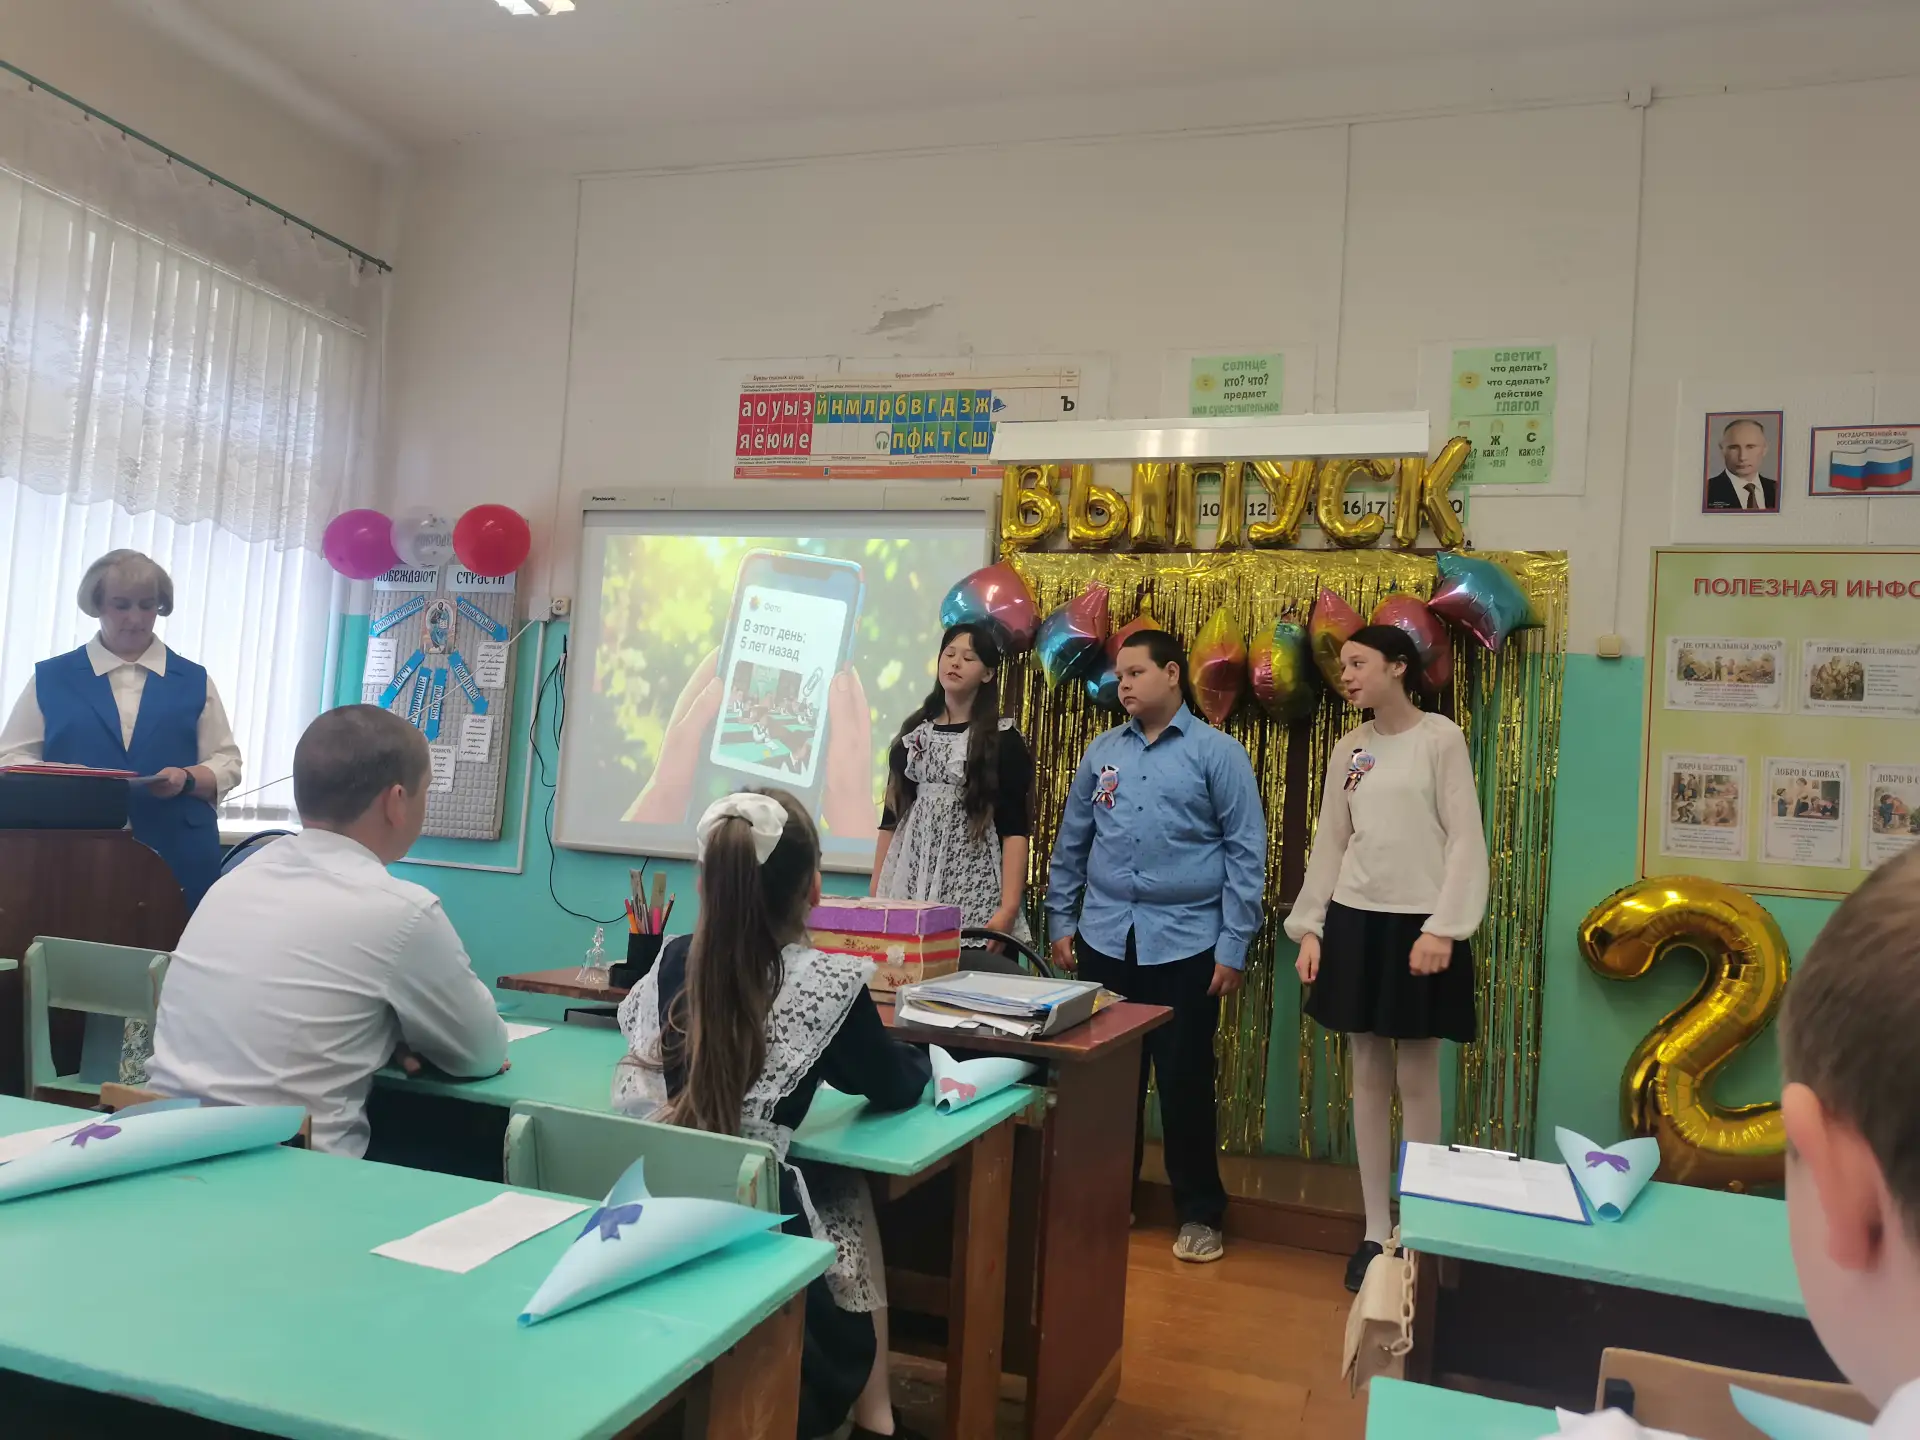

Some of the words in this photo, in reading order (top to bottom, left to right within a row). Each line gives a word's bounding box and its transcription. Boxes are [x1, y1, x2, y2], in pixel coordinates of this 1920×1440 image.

[1494, 351, 1542, 362] светит
[1222, 359, 1267, 372] солнце
[1509, 363, 1548, 373] делать?
[1224, 374, 1245, 387] кто?
[1248, 373, 1269, 386] что?
[1505, 376, 1550, 387] сделать?
[1224, 390, 1267, 401] предмет
[1494, 389, 1543, 400] действие
[1192, 406, 1207, 415] имя
[1496, 400, 1540, 412] глагол
[1483, 447, 1508, 457] какая?
[1519, 446, 1545, 456] какое?
[1000, 437, 1468, 550] ВЫПУСК
[1202, 503, 1220, 516] 10
[1249, 503, 1267, 516] 12
[1343, 501, 1361, 514] 16
[1366, 502, 1386, 515] 17
[1693, 578, 1838, 597] ПОЛЕЗНАЯ
[743, 619, 751, 632] В
[753, 622, 776, 637] этот
[776, 628, 807, 644] день:
[740, 636, 747, 649] 5
[748, 640, 767, 652] лет
[768, 643, 800, 662] назад
[1775, 768, 1799, 776] ДОБРО
[1877, 774, 1903, 783] ДОБРО
